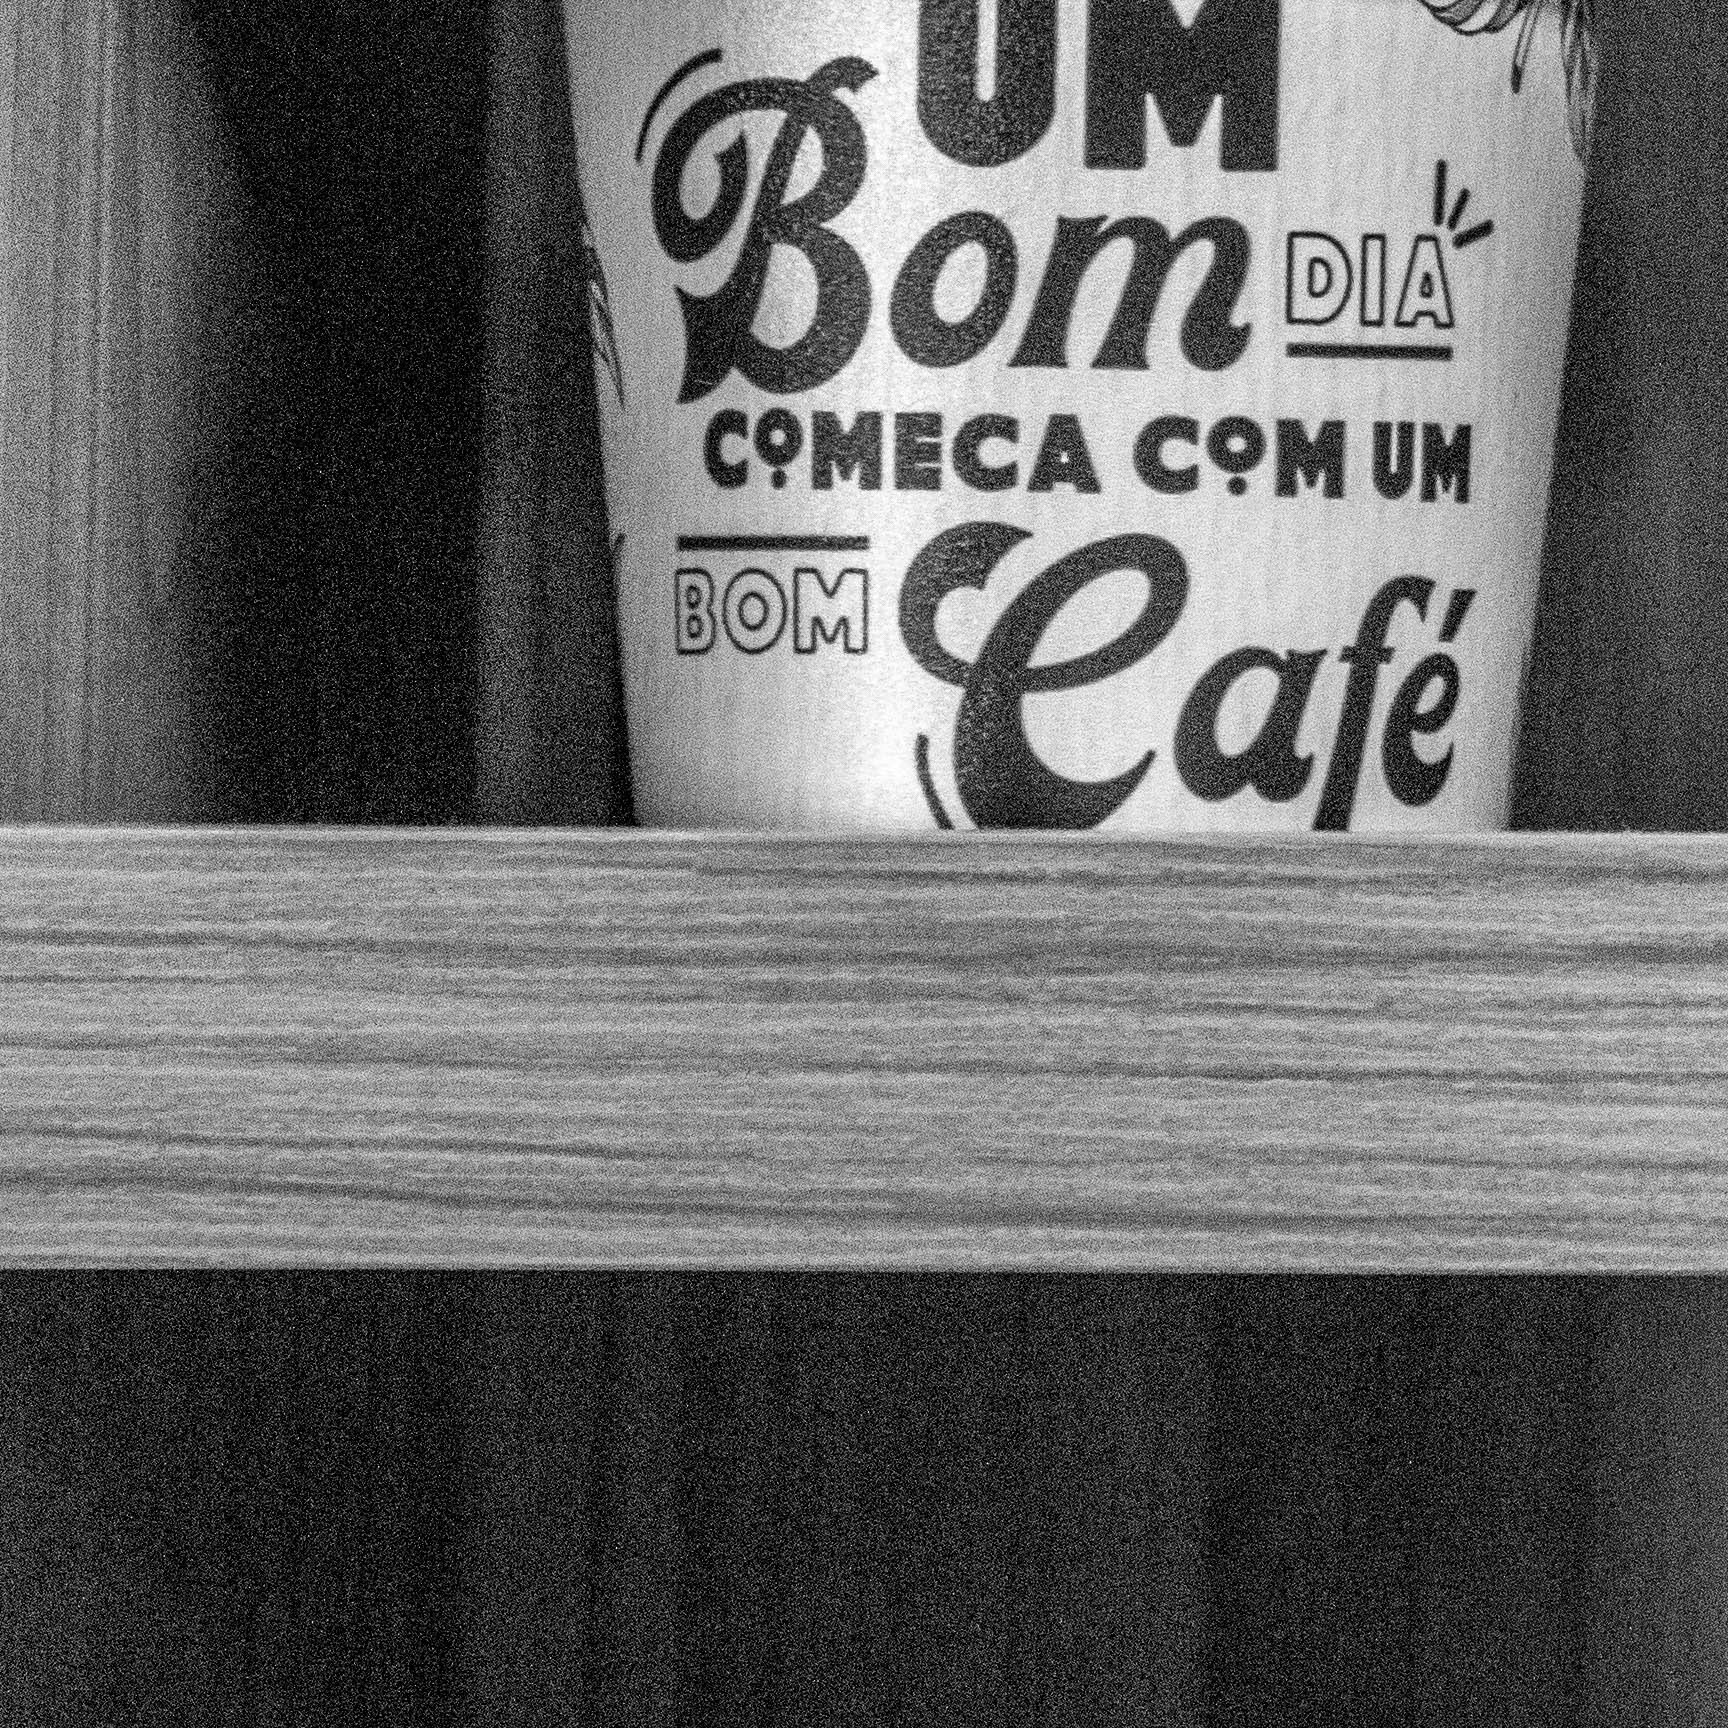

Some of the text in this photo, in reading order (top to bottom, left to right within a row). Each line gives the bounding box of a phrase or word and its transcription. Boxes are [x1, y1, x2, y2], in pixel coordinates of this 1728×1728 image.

[649, 55, 1457, 405] Bom DIA
[1132, 415, 1348, 500] COM
[1372, 420, 1475, 506] UM
[673, 520, 1477, 832] BOM Café
